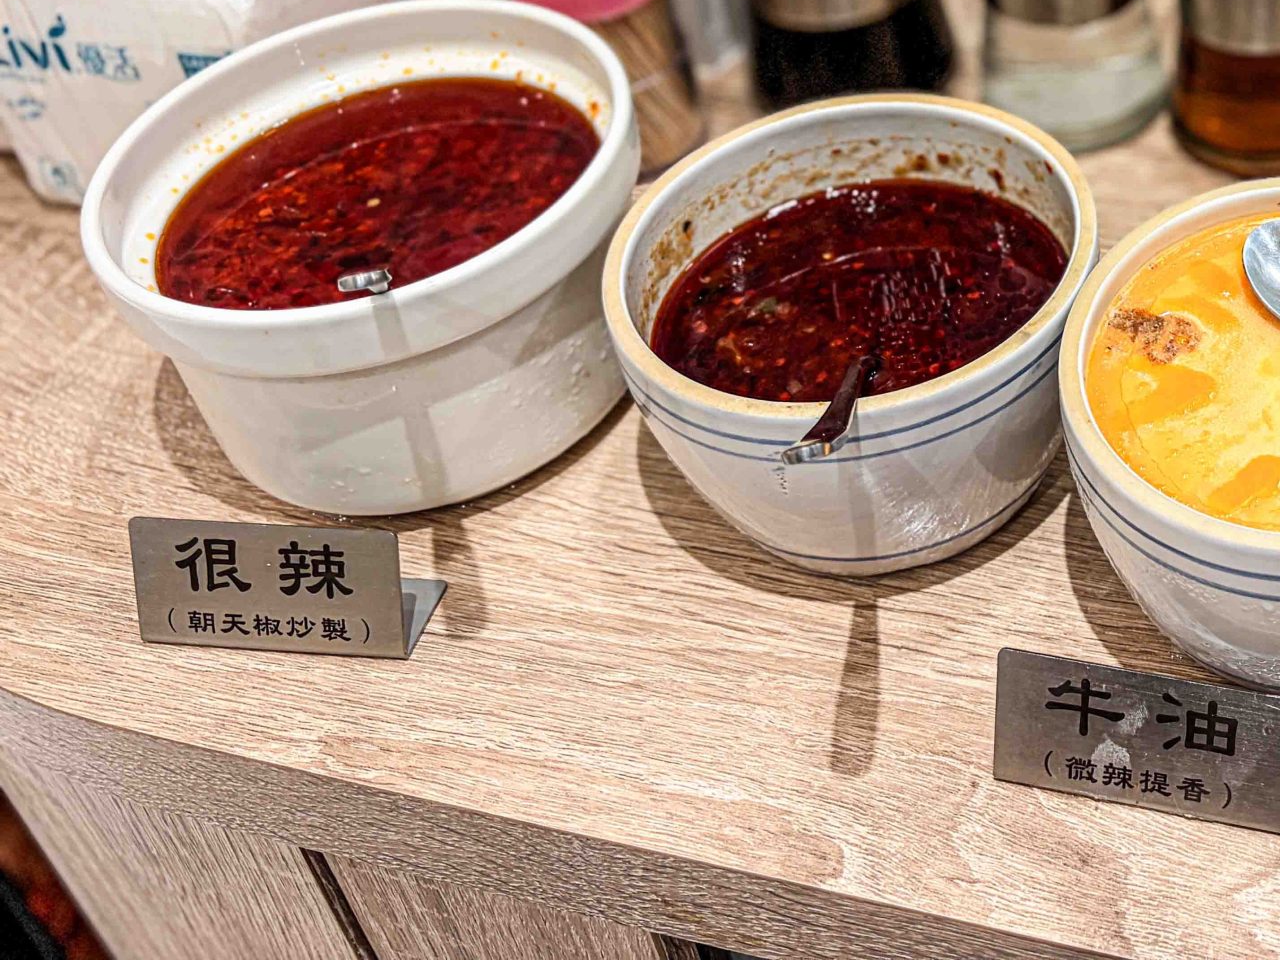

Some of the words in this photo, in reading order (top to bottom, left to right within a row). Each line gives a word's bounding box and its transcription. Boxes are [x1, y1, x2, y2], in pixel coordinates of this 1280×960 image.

[0, 14, 71, 72] ivi
[174, 536, 354, 600] 很辣
[1044, 677, 1239, 757] 牛油
